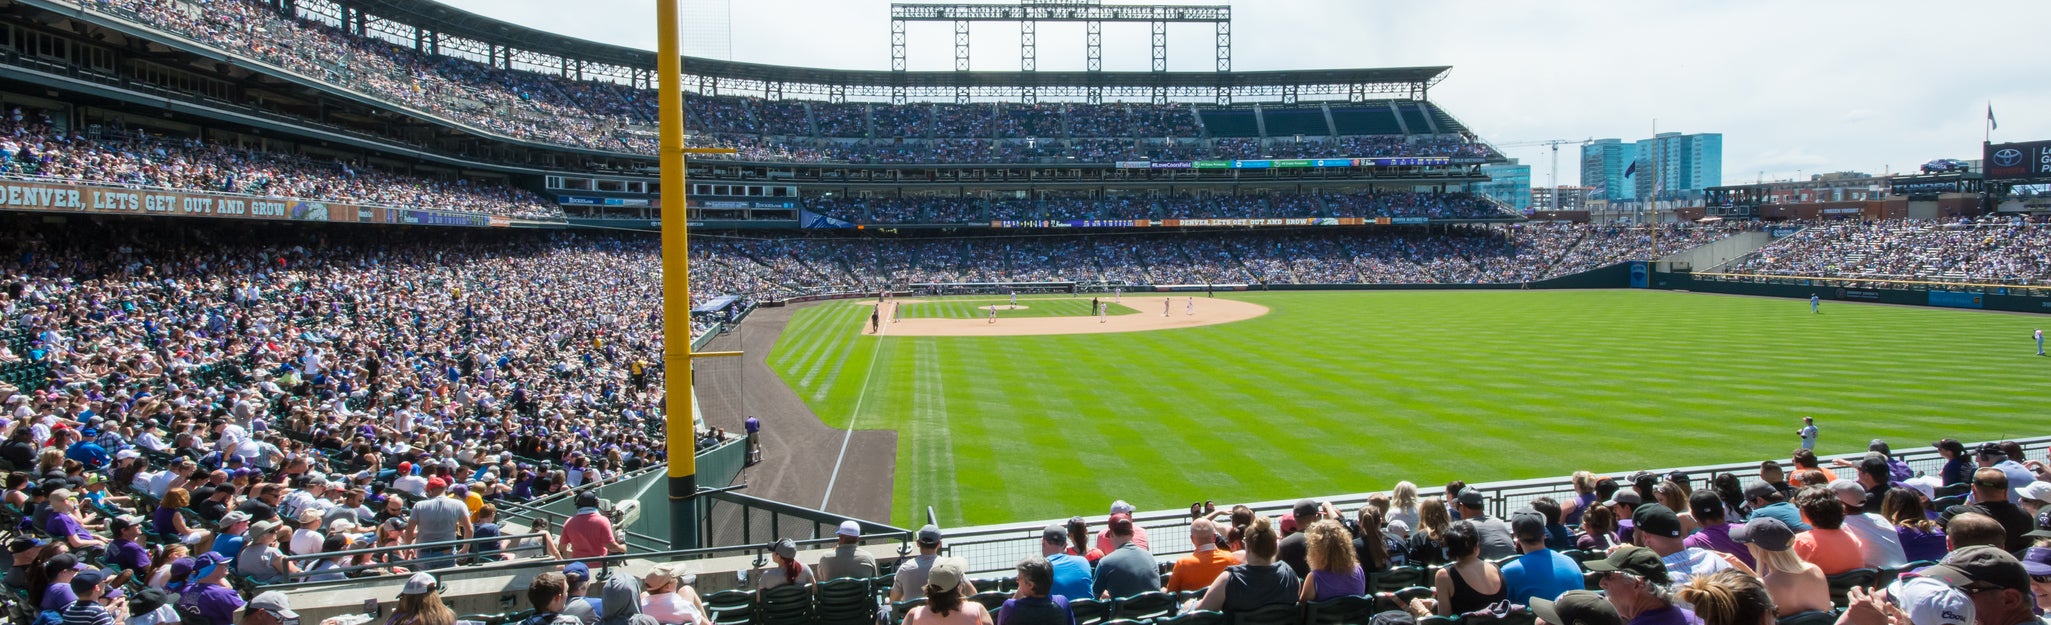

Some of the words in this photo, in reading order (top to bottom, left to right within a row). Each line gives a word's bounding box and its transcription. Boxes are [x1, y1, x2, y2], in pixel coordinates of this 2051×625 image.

[1928, 162, 1947, 170] TOYOTA
[1991, 167, 2025, 175] TOYOTA
[93, 191, 139, 210] LETS
[145, 195, 177, 212] GET
[183, 197, 213, 214] OUT
[217, 199, 245, 215] AND
[251, 201, 286, 217] GROW
[1941, 610, 1966, 623] Coors
